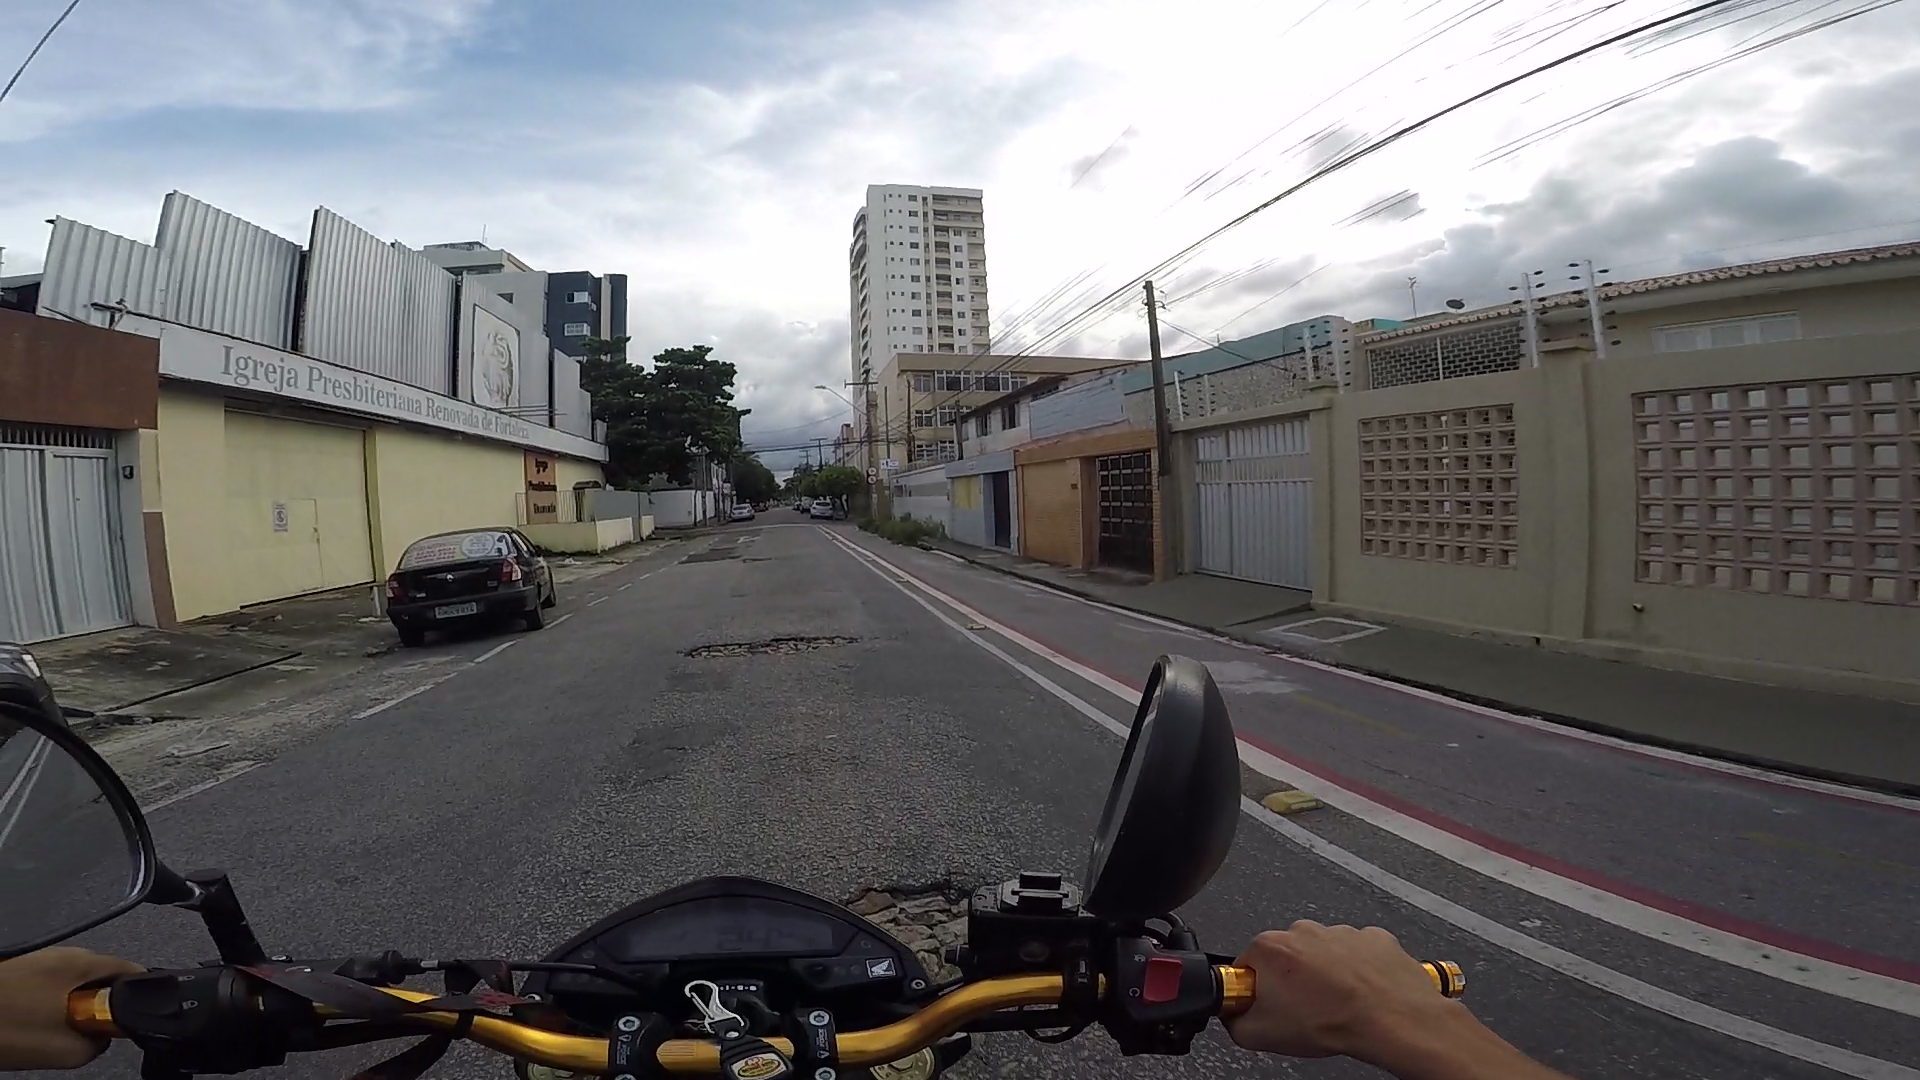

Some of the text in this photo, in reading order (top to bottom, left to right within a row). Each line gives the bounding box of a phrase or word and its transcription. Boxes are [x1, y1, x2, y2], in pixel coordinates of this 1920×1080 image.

[220, 345, 530, 440] Igreja Presbiteriana Renovada de Fortaleza
